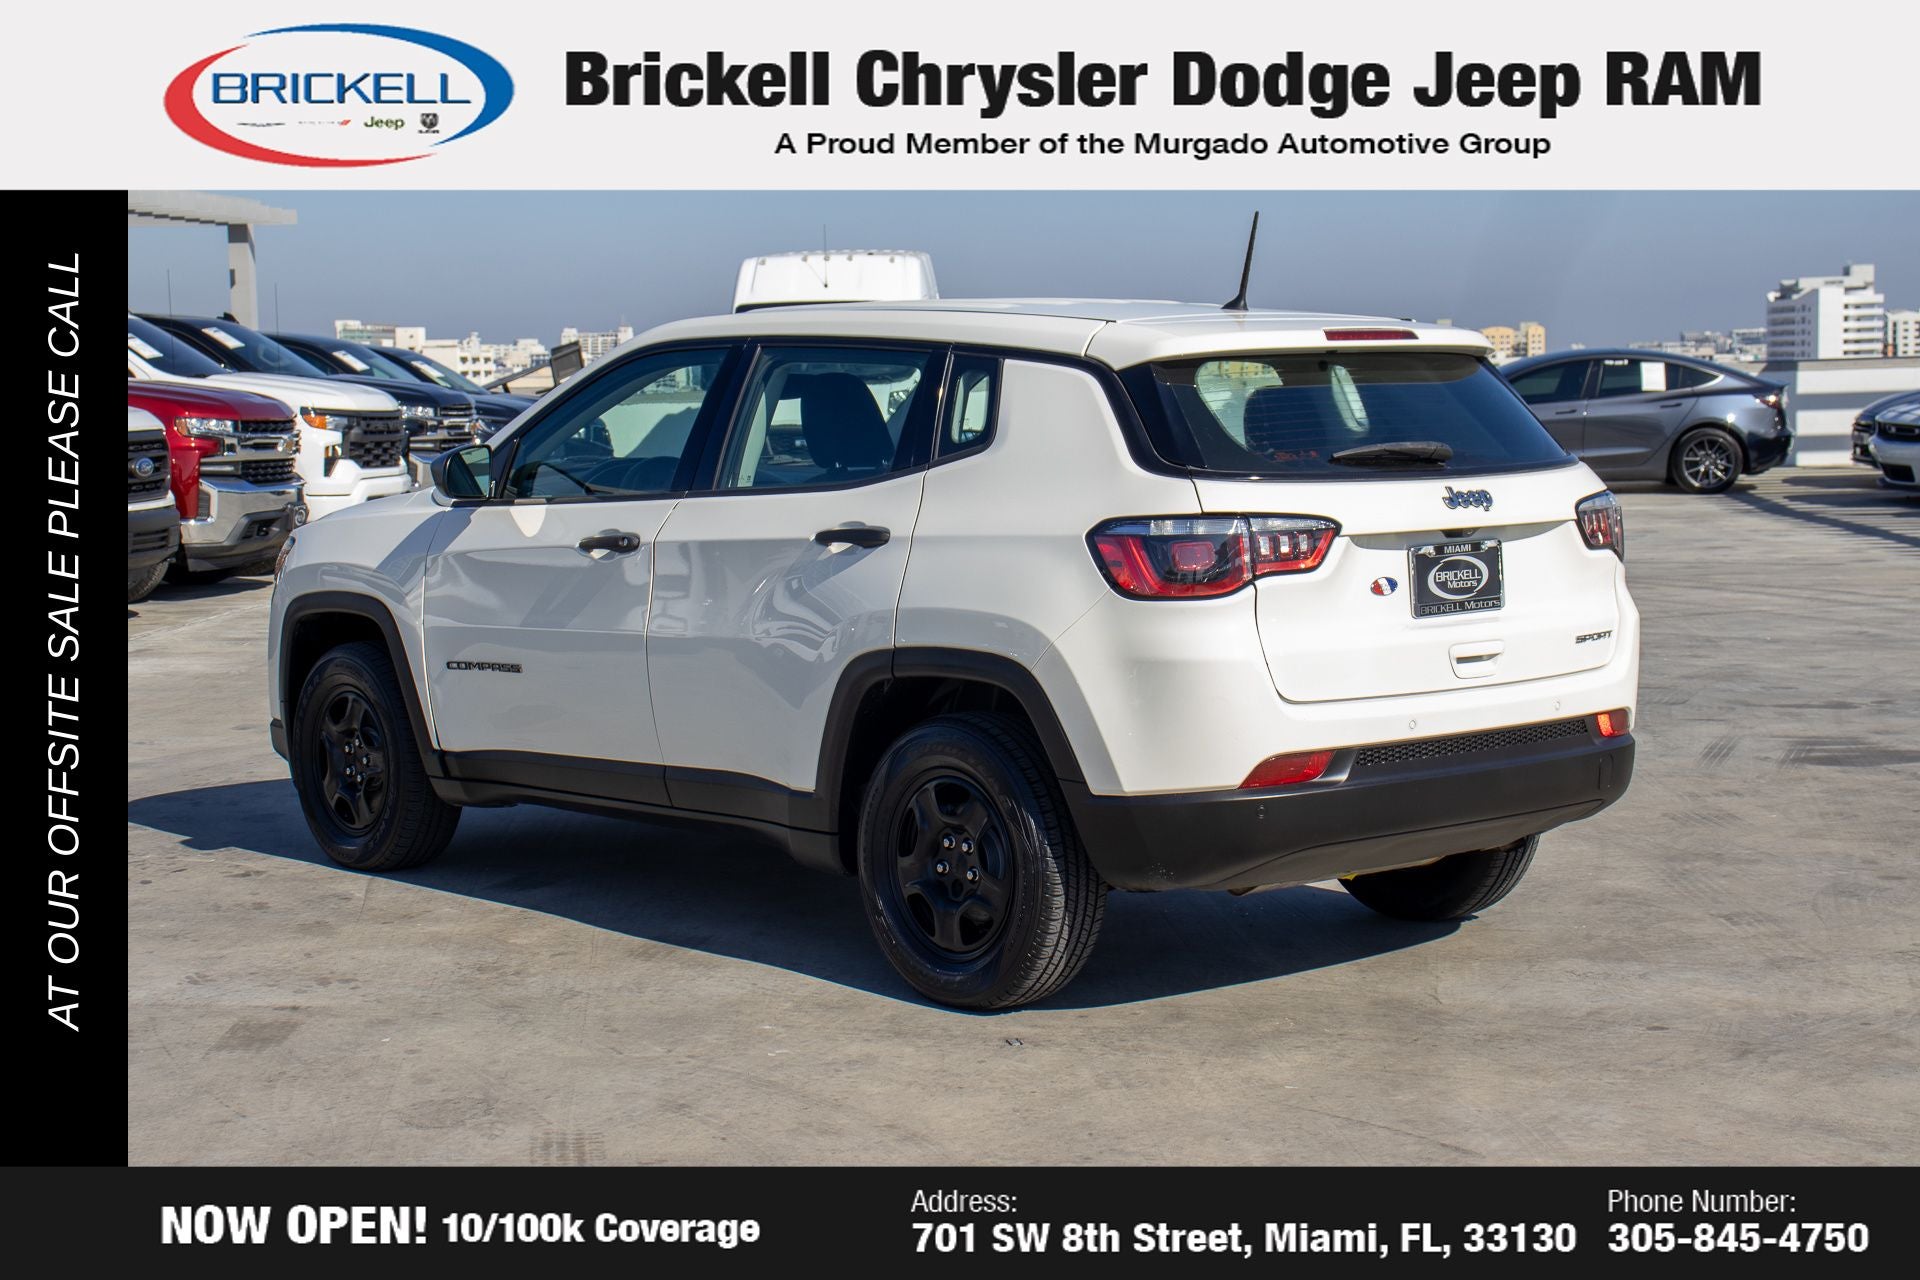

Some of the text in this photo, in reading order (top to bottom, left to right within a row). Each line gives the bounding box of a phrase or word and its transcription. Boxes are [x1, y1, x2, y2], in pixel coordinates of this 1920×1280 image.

[1442, 486, 1493, 511] Jeep
[1444, 544, 1472, 554] MIAMI
[1435, 568, 1481, 583] BRICKELL
[1447, 580, 1478, 589] Motors
[1420, 600, 1501, 615] BRICKELL Motors
[1575, 630, 1613, 644] SPORT
[446, 661, 523, 673] COMPASS
